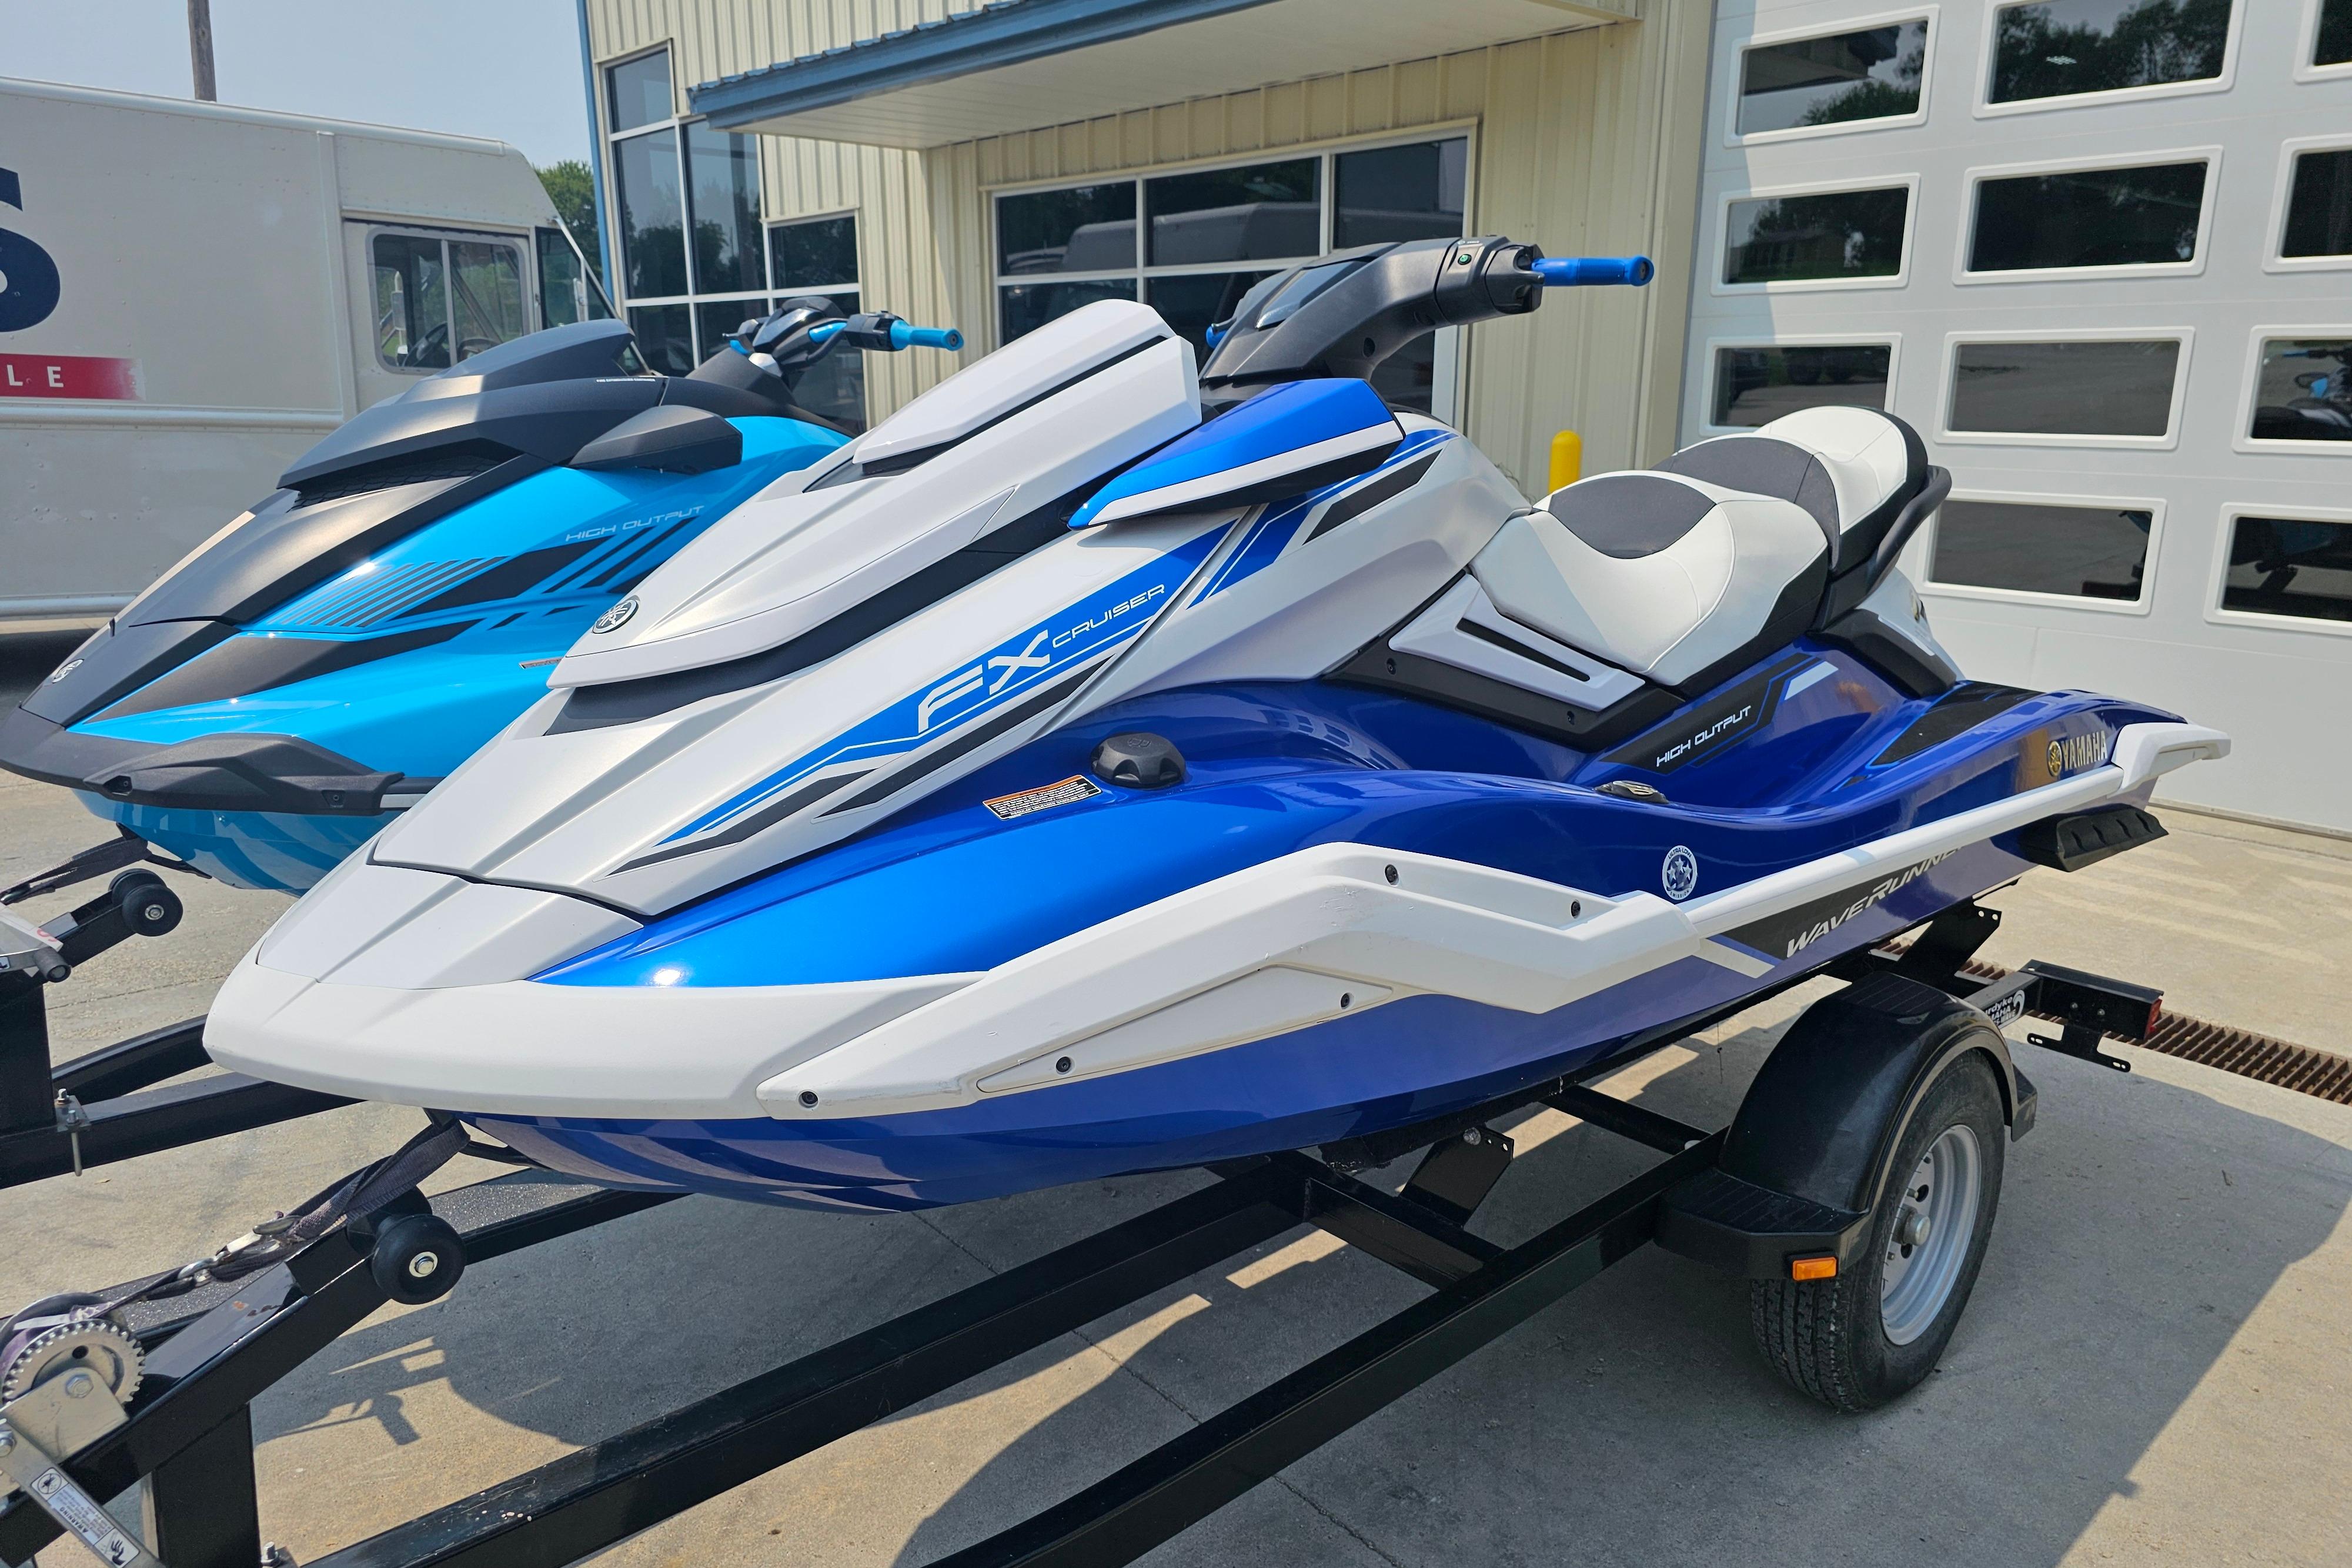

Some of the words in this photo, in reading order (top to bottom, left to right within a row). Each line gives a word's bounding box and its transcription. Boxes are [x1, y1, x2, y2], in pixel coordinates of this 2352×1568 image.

[566, 525, 617, 541] HIGH
[622, 506, 704, 530] OUTPUT
[918, 629, 1050, 733] FX
[1052, 584, 1165, 648] CRUISER
[1656, 739, 1691, 767] HIGH
[1695, 705, 1752, 745] OUTPUT
[2061, 730, 2108, 771] YAMAHA
[1668, 848, 1681, 859] ULTRA
[1682, 848, 1692, 858] LOW
